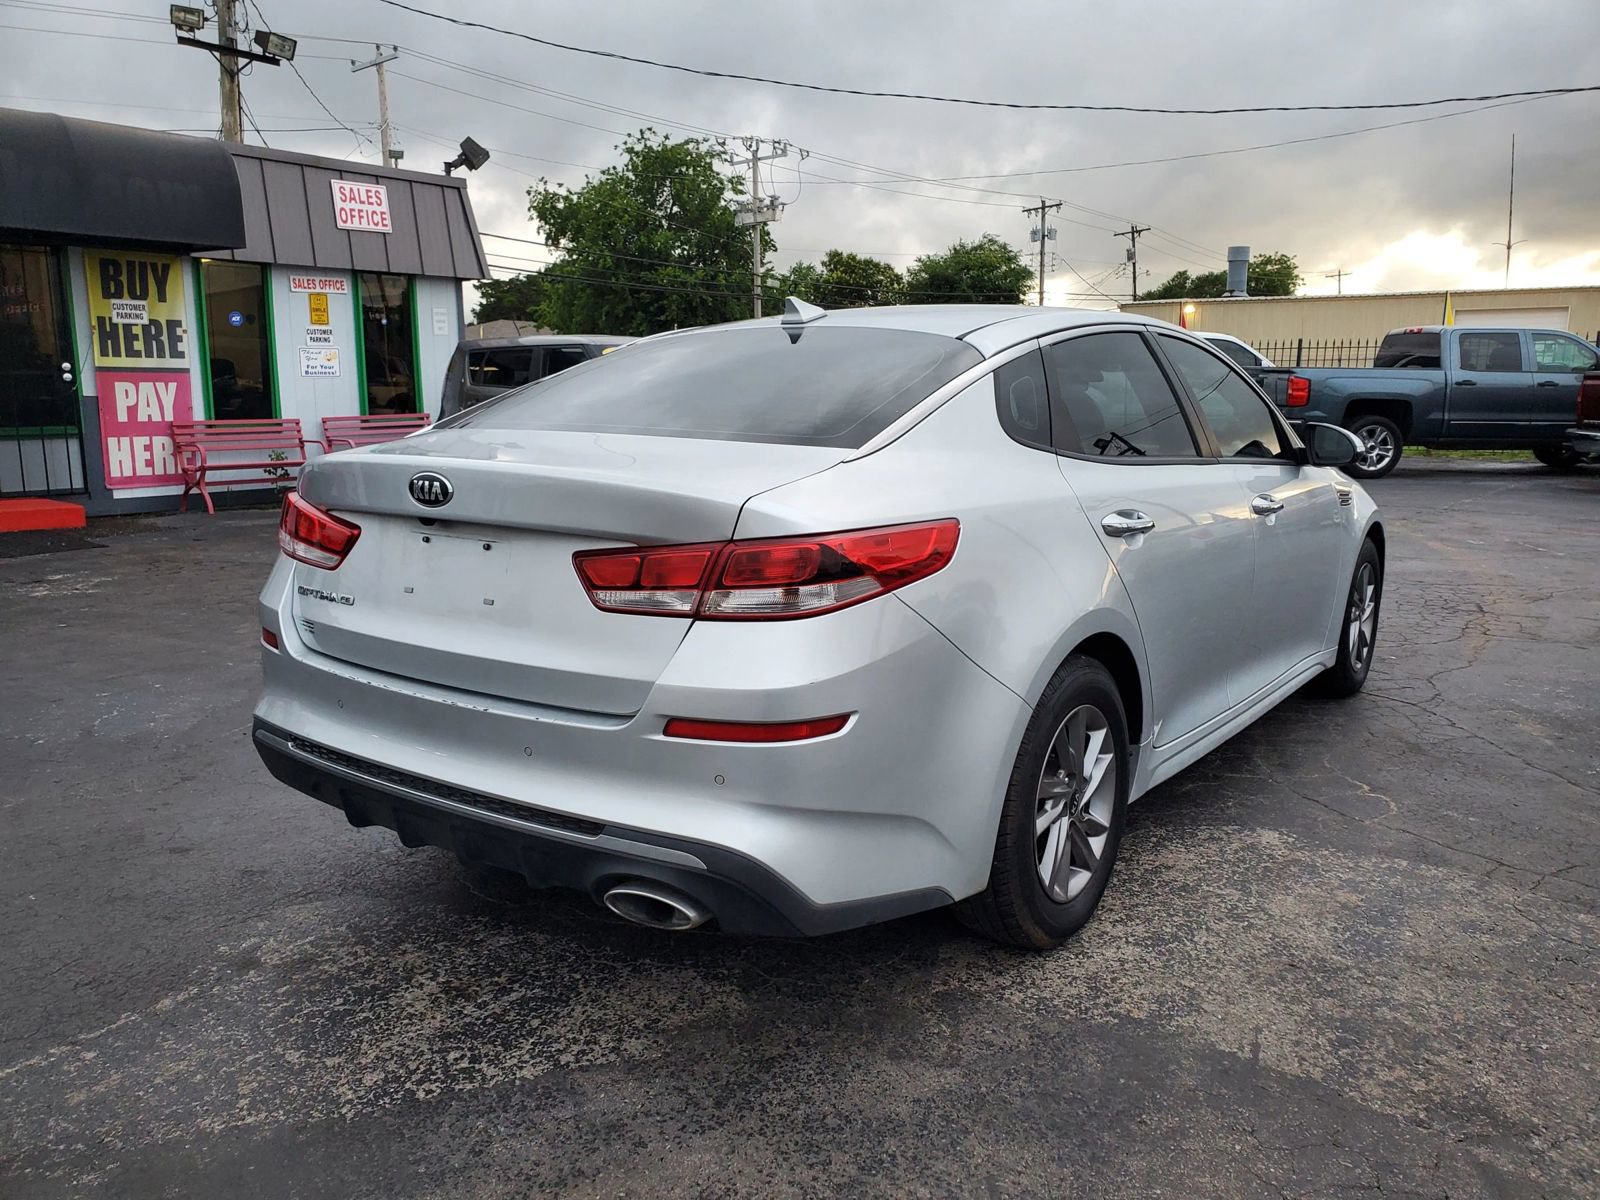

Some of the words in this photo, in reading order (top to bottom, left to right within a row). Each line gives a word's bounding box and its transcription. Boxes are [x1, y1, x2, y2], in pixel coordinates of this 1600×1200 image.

[338, 185, 383, 207] SALES
[339, 206, 389, 228] OFFICE
[99, 257, 171, 303] BUY
[292, 277, 317, 290] SALES
[318, 279, 346, 291] OFFICE
[112, 302, 146, 312] CUSTOMER
[116, 311, 144, 321] PARKING
[96, 315, 186, 359] HERE
[306, 328, 333, 336] CUSTOMER
[309, 335, 332, 344] PARKING
[319, 363, 335, 371] Your
[114, 381, 177, 423] PAY
[413, 479, 444, 501] KIA
